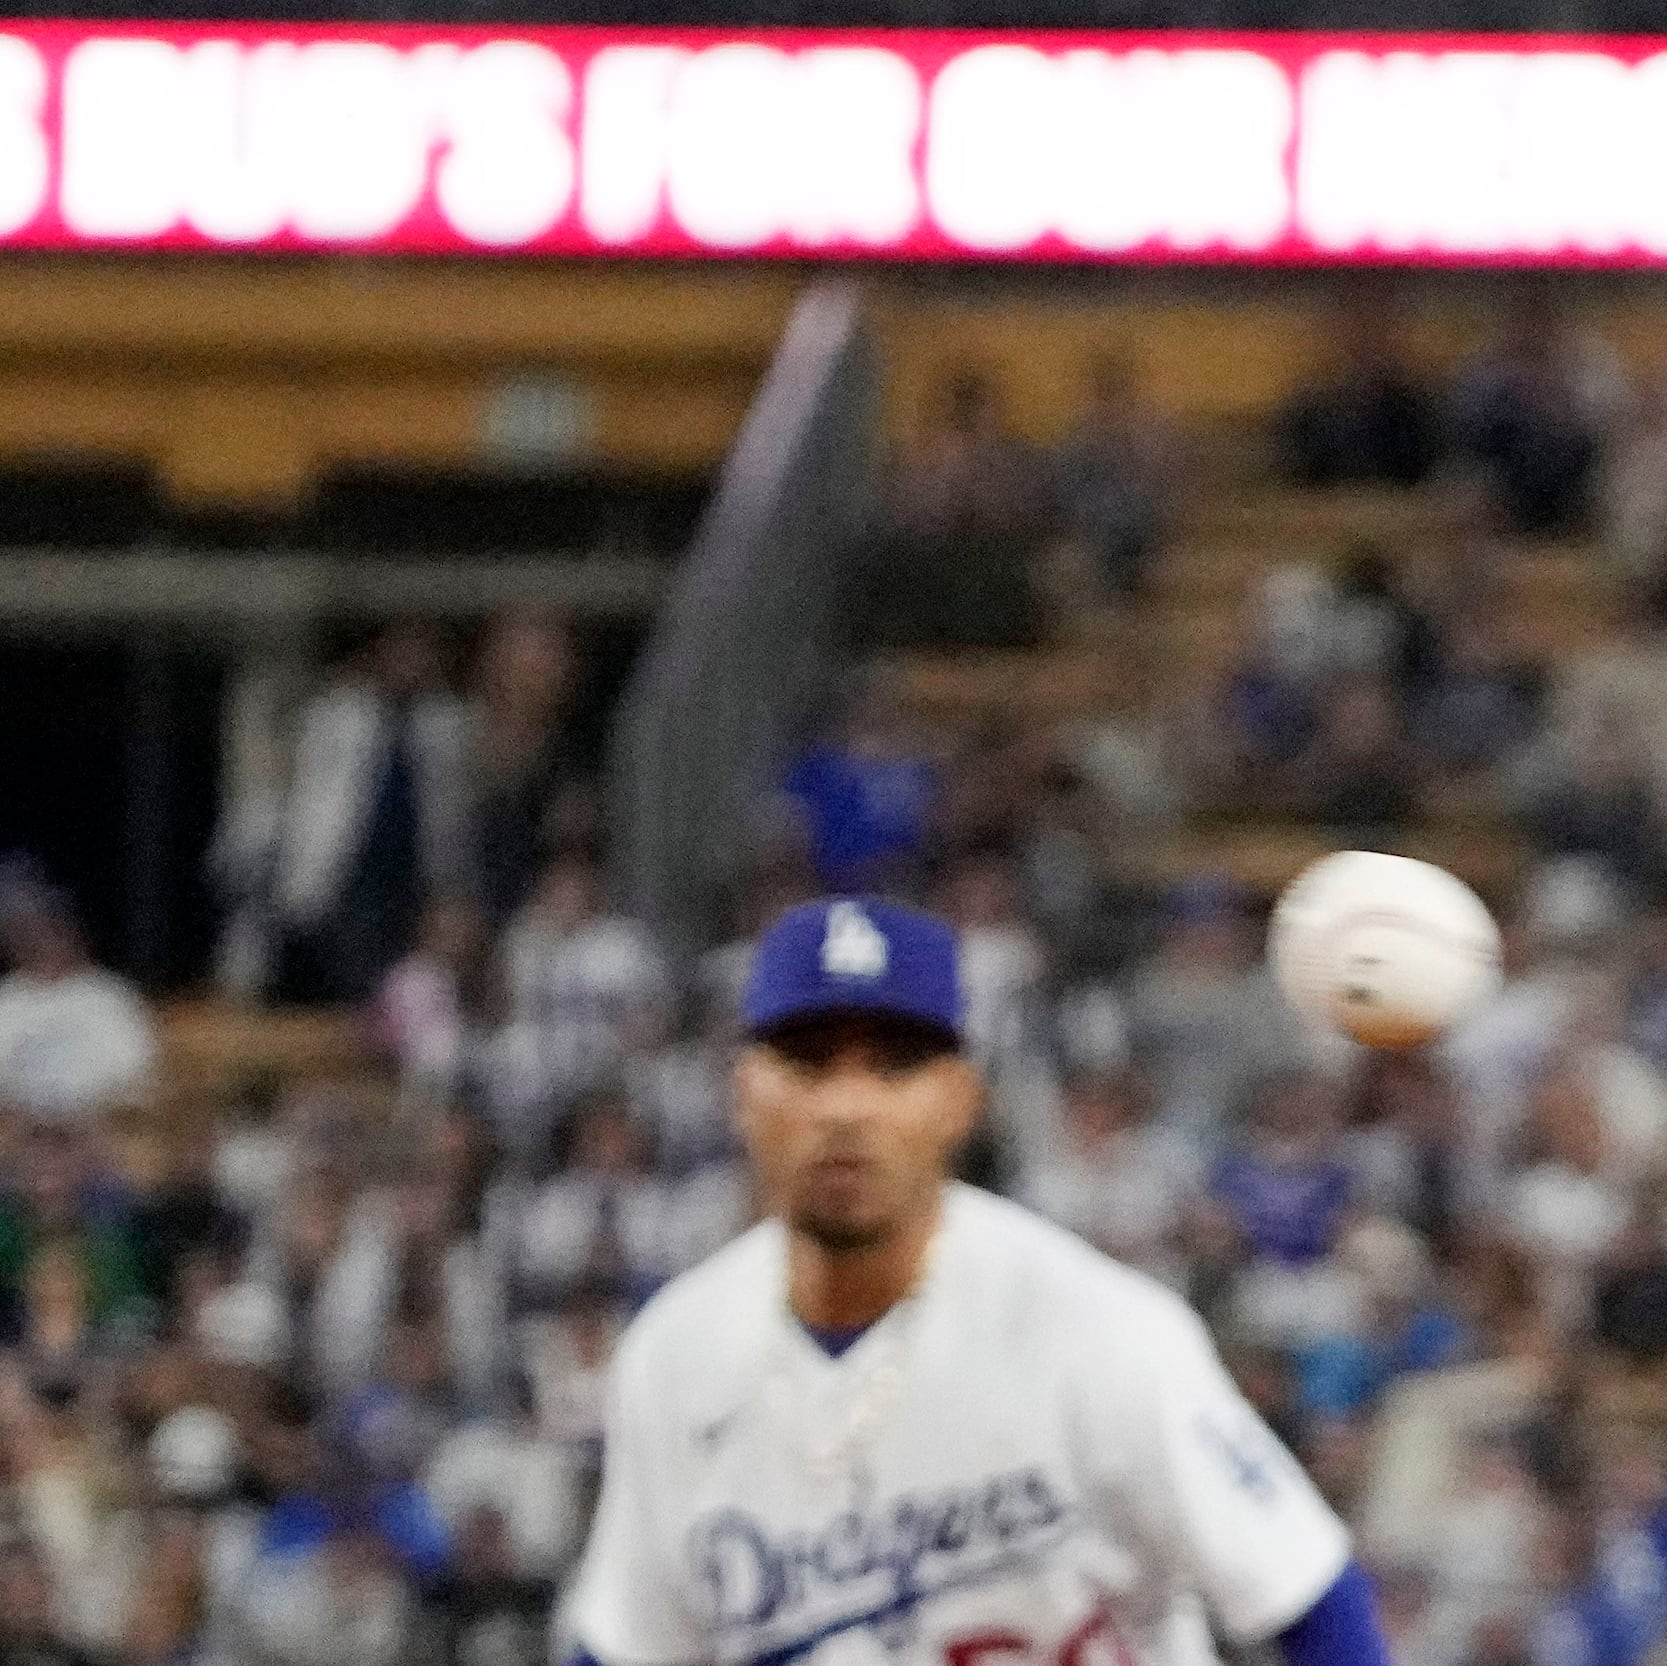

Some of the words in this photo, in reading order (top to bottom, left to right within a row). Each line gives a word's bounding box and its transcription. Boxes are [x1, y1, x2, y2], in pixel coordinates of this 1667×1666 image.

[580, 42, 925, 250] FOR
[925, 44, 1294, 254] OUR
[683, 1468, 1068, 1660] Dodgers
